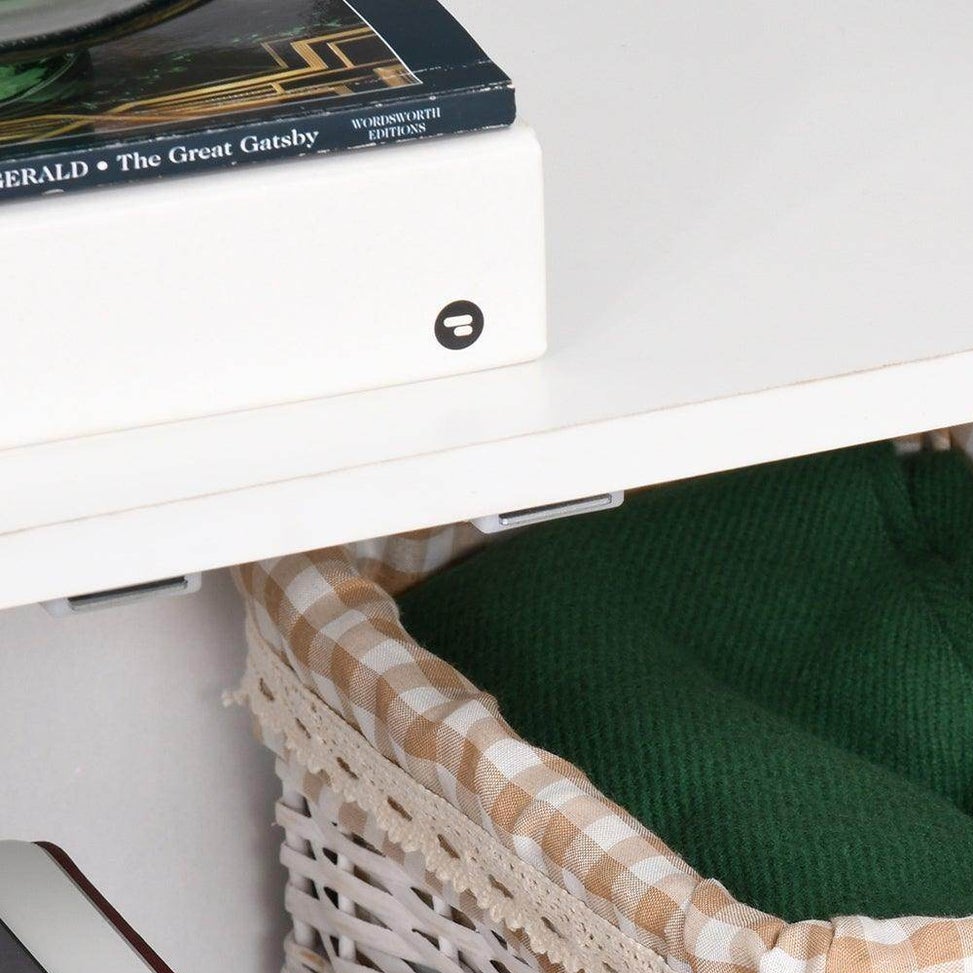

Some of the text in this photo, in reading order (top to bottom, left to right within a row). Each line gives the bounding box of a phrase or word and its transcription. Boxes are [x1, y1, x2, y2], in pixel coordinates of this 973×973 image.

[352, 107, 441, 129] WORDSWORTH
[368, 122, 427, 141] EDITIONS
[0, 128, 319, 189] ERALD The Great Gatsby
